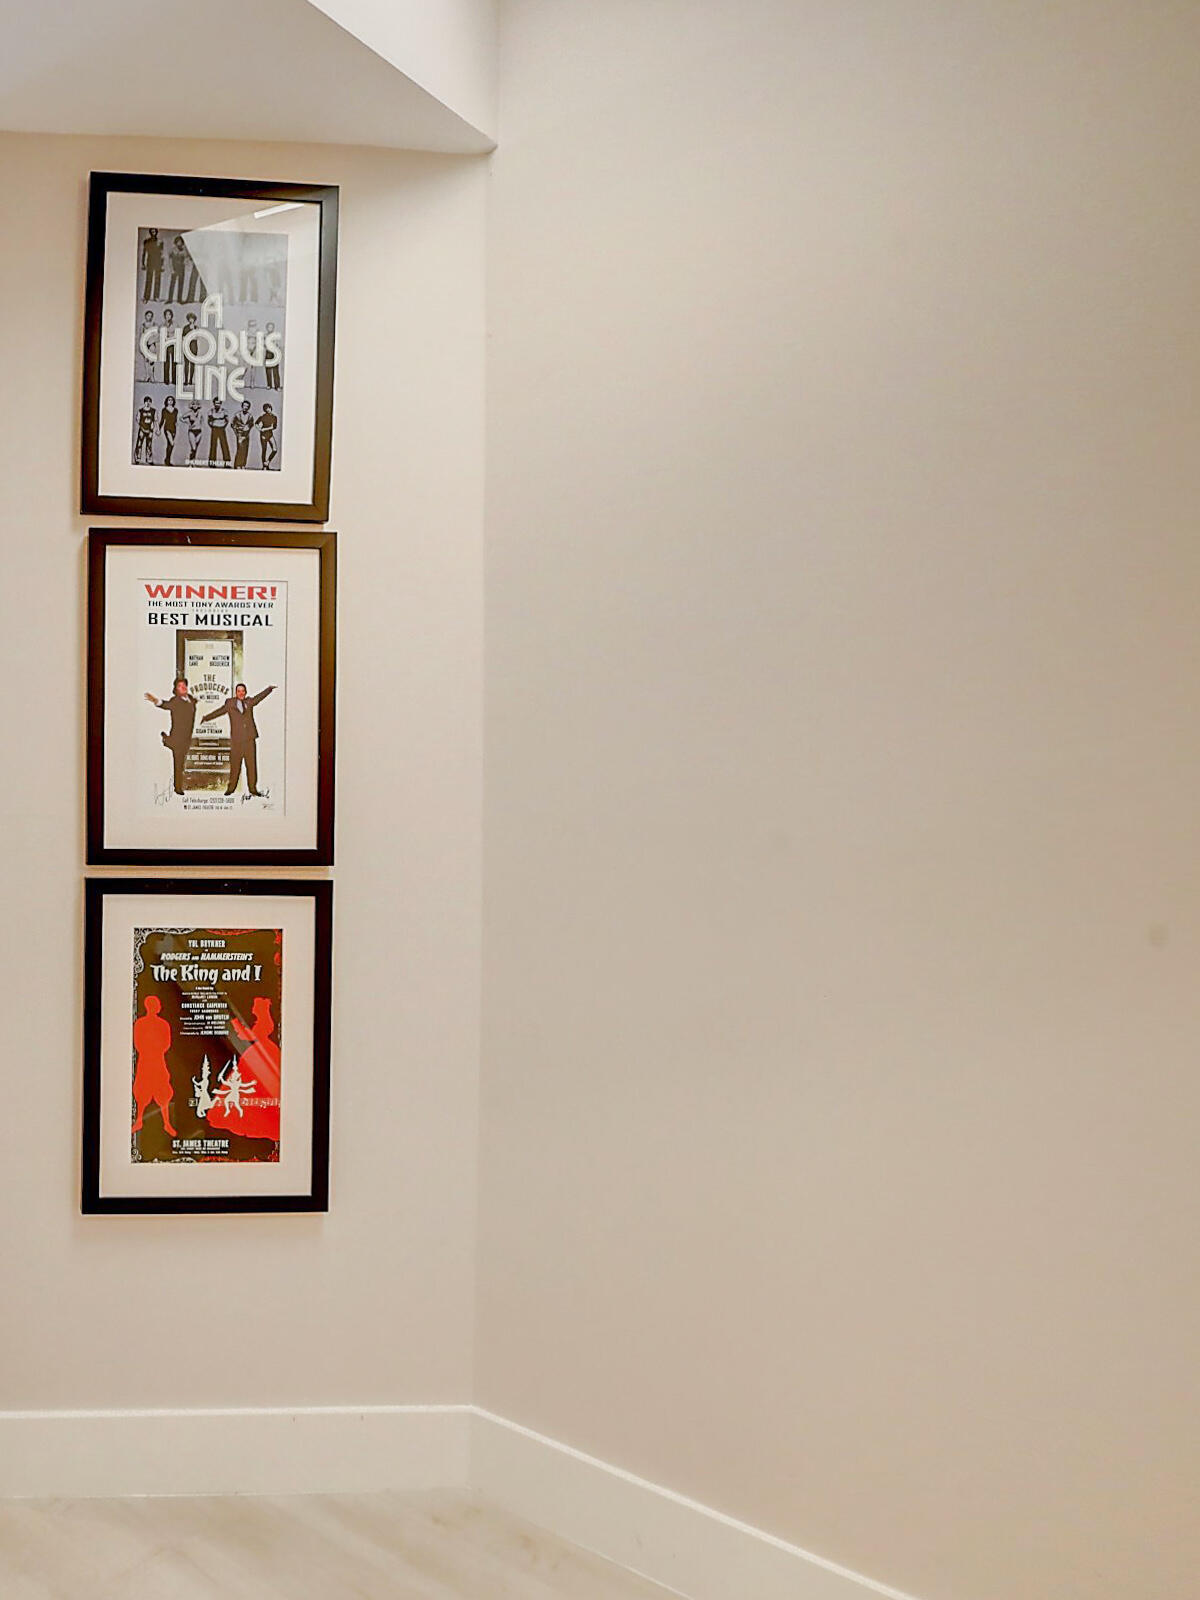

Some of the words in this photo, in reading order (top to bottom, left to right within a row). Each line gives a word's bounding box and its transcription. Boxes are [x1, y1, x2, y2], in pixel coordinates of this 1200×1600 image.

[201, 292, 223, 328] A
[140, 326, 282, 367] CHORUS
[175, 363, 246, 402] LINE
[145, 584, 277, 600] WINNER!
[148, 612, 189, 625] BEST
[195, 613, 273, 626] MUSICAL
[203, 674, 216, 682] THE
[190, 683, 230, 695] PRODUCERS
[160, 952, 192, 960] RODGERS
[200, 952, 254, 961] HAMMERSTEIN'S
[150, 964, 178, 982] The
[179, 964, 219, 985] King
[221, 964, 251, 982] and
[253, 965, 262, 981] I
[172, 1139, 182, 1148] ST.
[183, 1139, 202, 1147] JAMES
[203, 1139, 230, 1148] THEATRE
